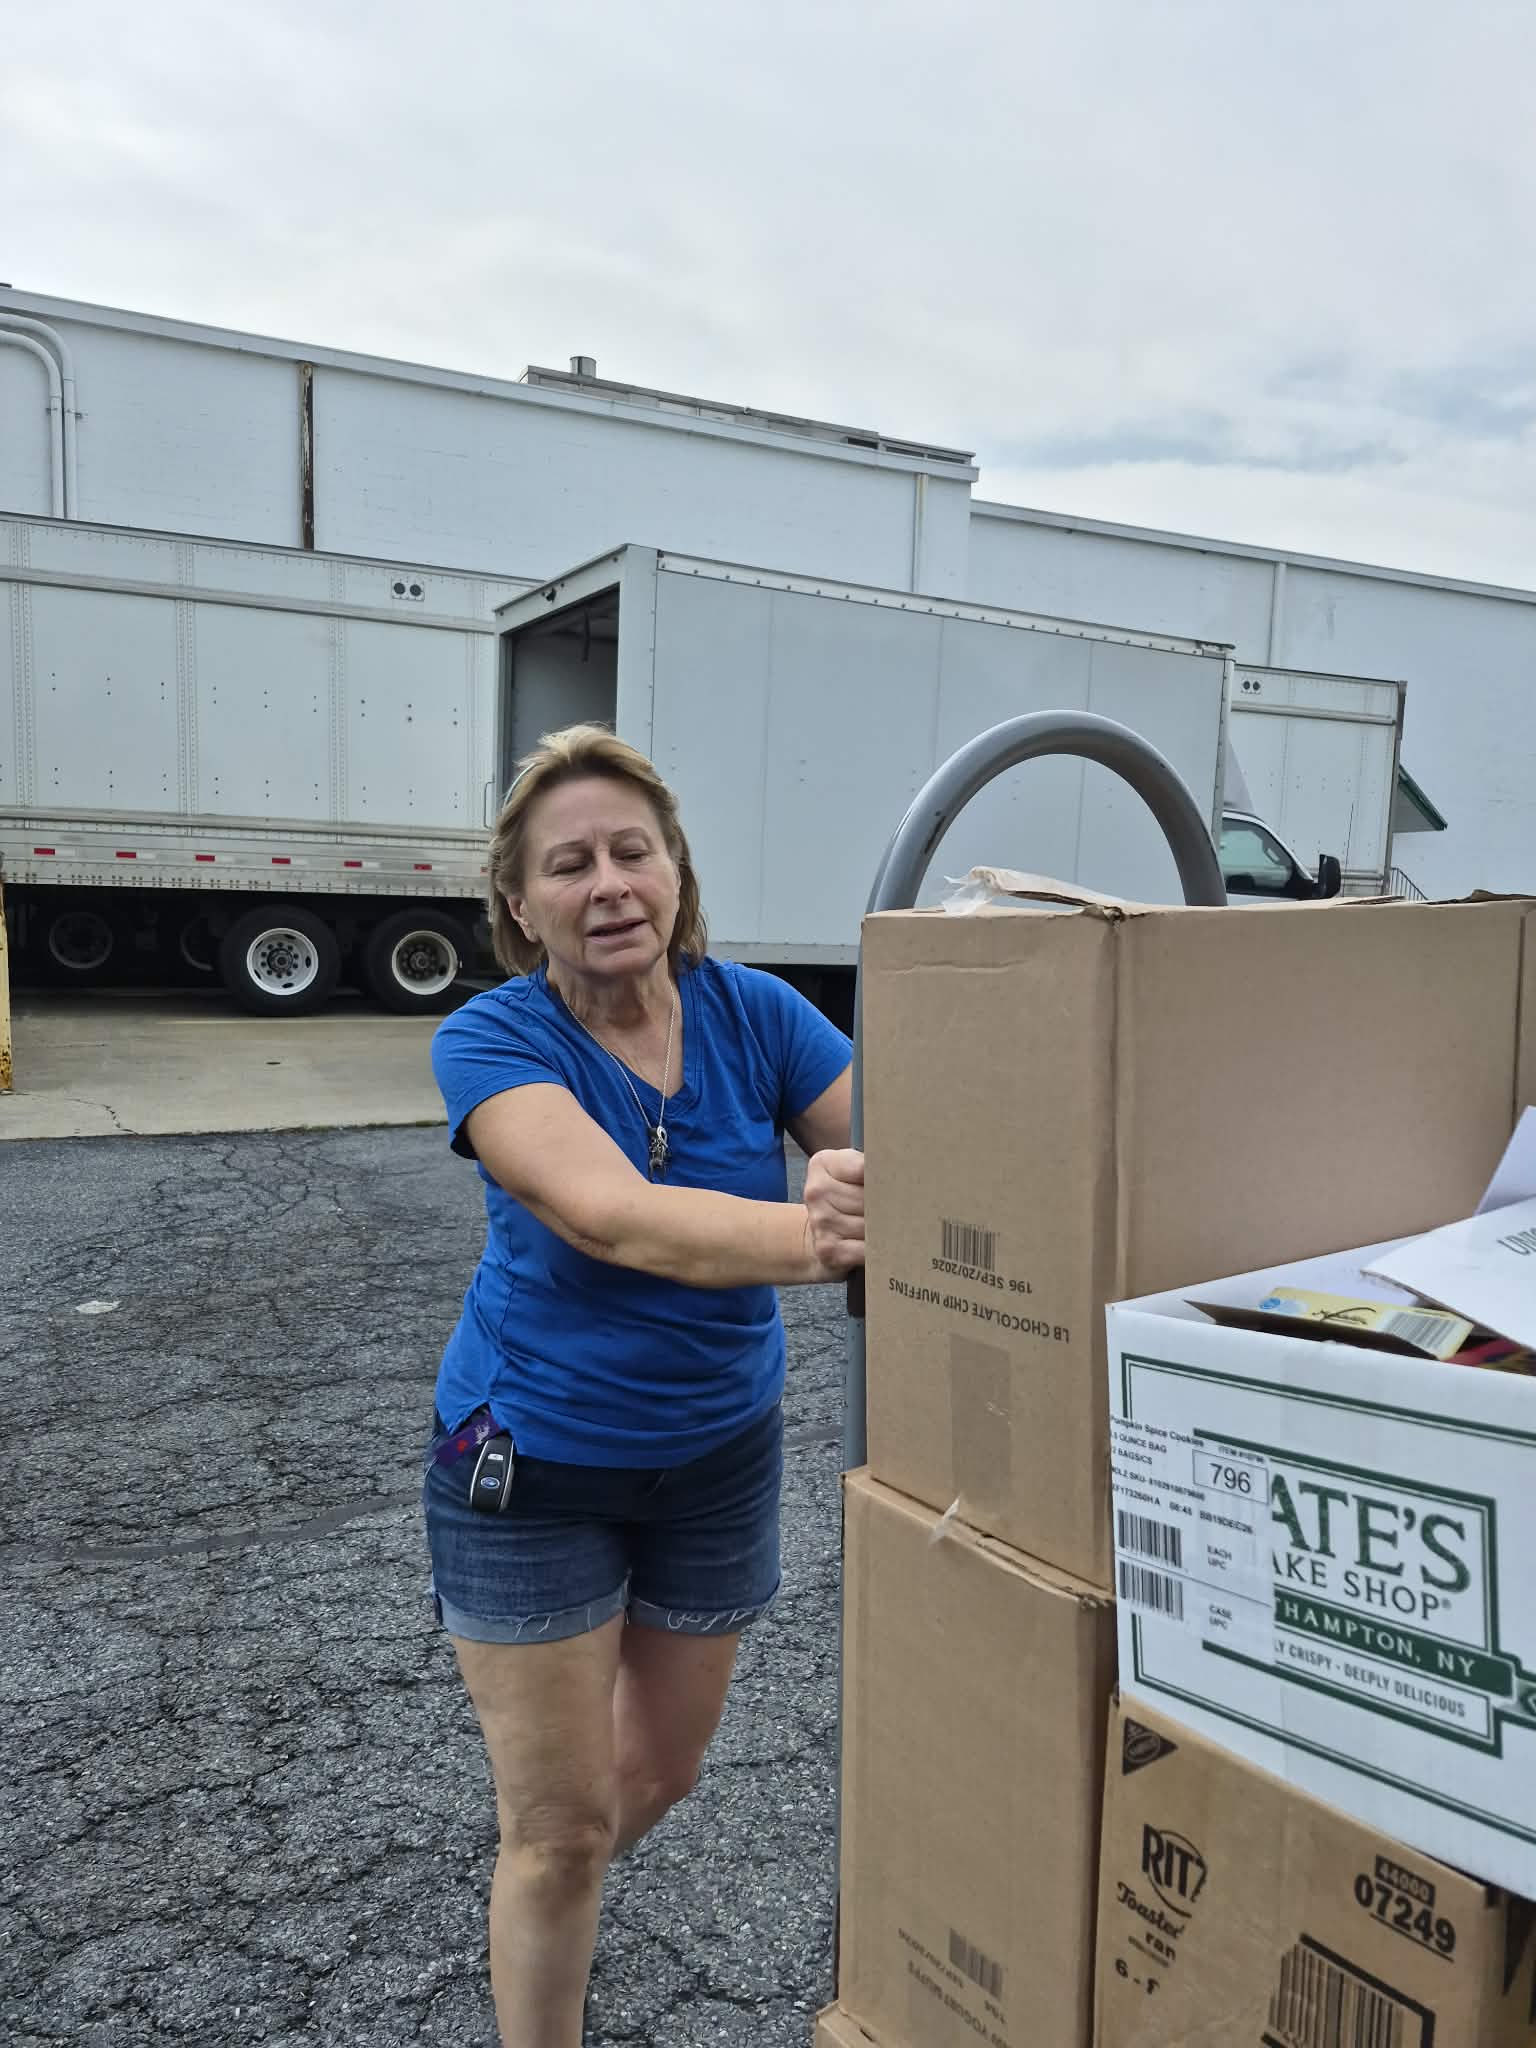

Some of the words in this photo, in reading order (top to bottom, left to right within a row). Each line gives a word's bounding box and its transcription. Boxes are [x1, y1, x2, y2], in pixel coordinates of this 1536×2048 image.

[932, 1258, 1004, 1289] SEP/20/2026
[1009, 1279, 1033, 1294] 196
[889, 1277, 940, 1305] MUFFINS
[943, 1295, 969, 1313] CHIP
[972, 1304, 1050, 1337] CHOCOLATE
[1053, 1327, 1070, 1344] LB
[1144, 1423, 1168, 1438] Spice
[1148, 1442, 1167, 1453] BAG
[1209, 1463, 1251, 1494] 796
[1272, 1474, 1471, 1593] ATE'S
[1274, 1597, 1422, 1663] HAMPTON,
[1437, 1649, 1475, 1677] NY
[1288, 1644, 1333, 1670] CRISPY
[1344, 1662, 1391, 1691] DEEPLY
[1394, 1679, 1466, 1718] DELICIOUS
[1354, 1873, 1456, 1953] 07249
